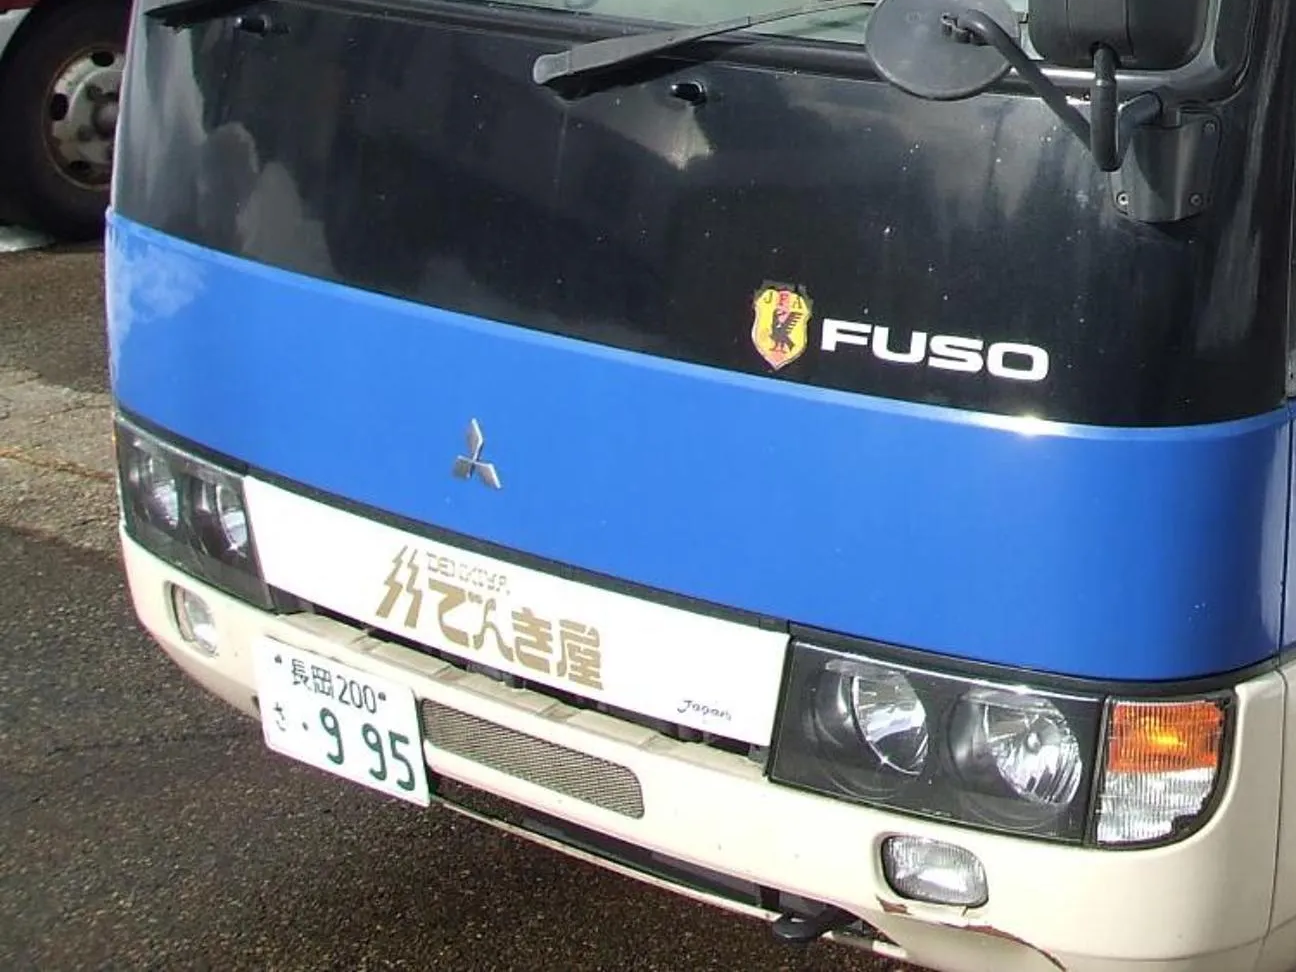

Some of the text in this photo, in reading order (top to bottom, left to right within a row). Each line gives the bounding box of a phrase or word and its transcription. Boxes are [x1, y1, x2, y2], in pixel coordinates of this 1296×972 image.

[820, 318, 1050, 382] FUSO
[428, 577, 604, 690] でんき屋
